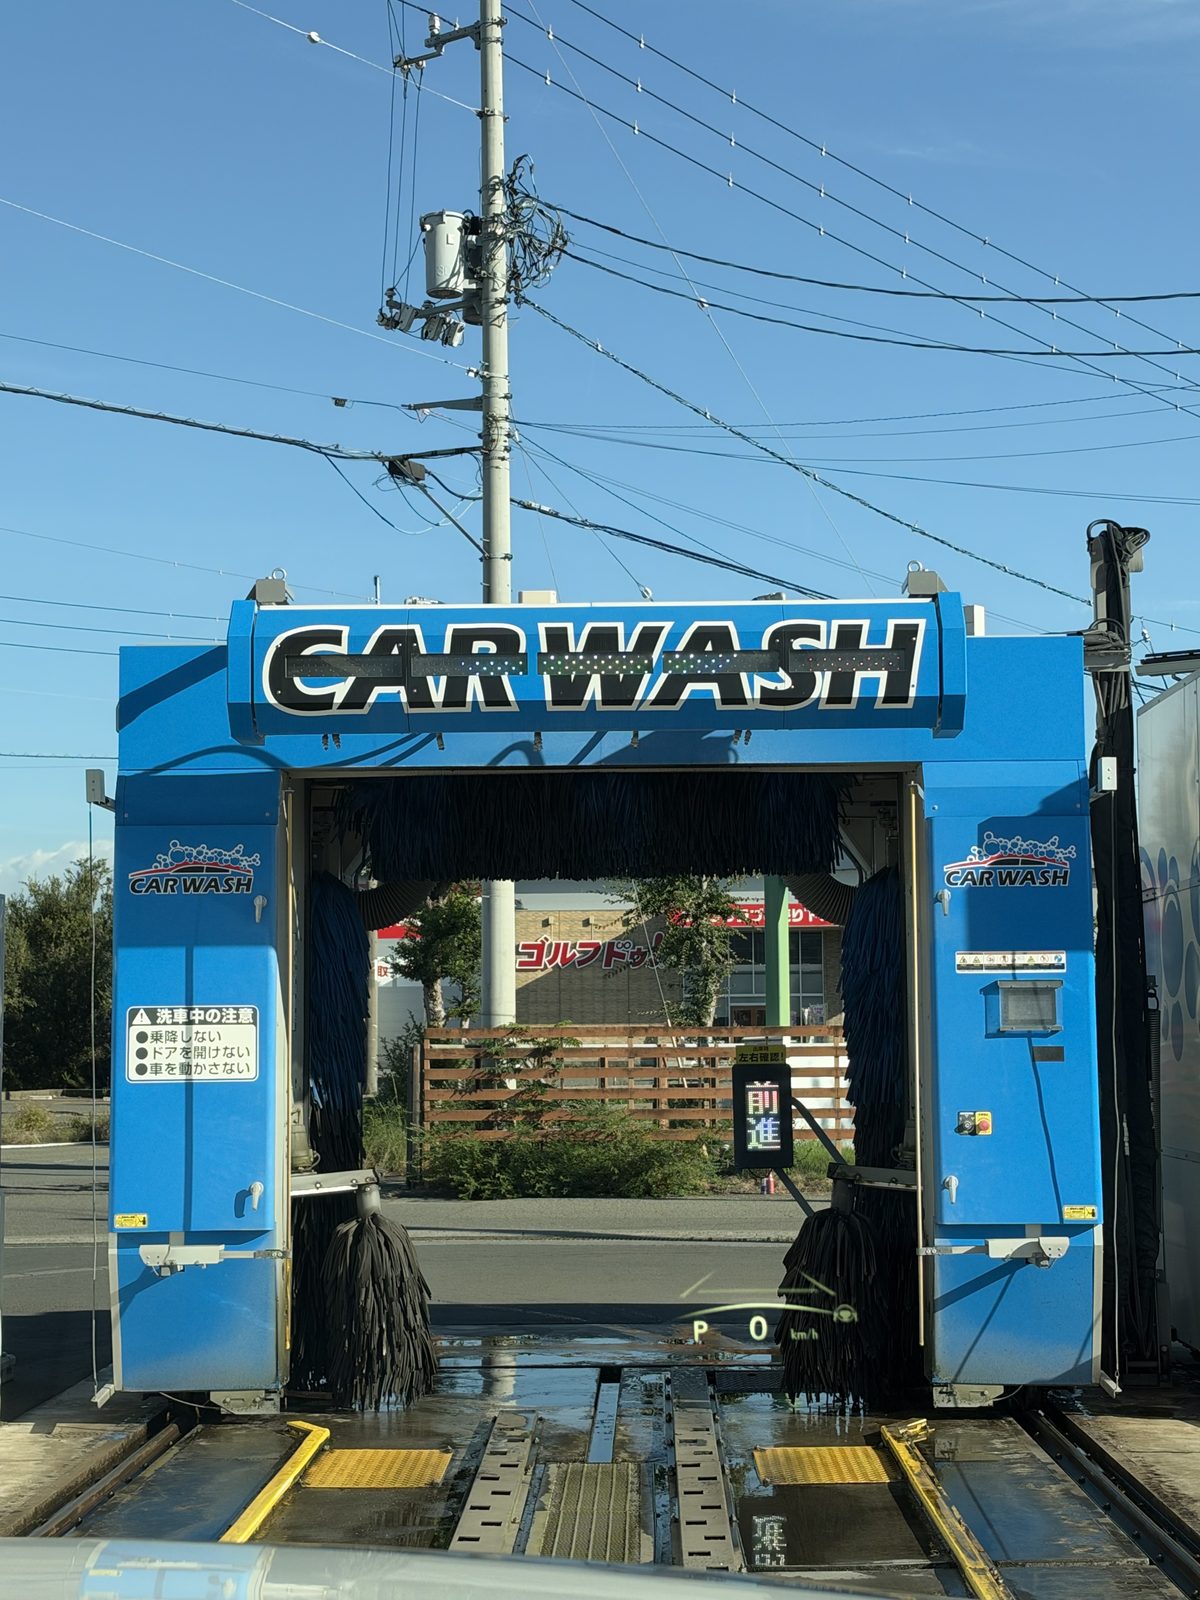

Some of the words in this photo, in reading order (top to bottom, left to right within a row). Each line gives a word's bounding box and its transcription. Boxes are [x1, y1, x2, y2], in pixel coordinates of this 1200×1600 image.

[263, 622, 527, 717] CAR
[536, 618, 926, 714] WASH
[129, 877, 179, 895] CAR
[181, 876, 254, 894] WASH
[945, 869, 994, 888] CAR
[996, 868, 1070, 887] WASH
[156, 1007, 254, 1025] 洗車中の注意
[149, 1030, 221, 1044] 乗降しない
[152, 1045, 250, 1060] ドアを開けない
[148, 1061, 250, 1076] 車を動かさない
[745, 1081, 781, 1149] 前進
[693, 1320, 708, 1343] P
[749, 1315, 768, 1341] 0
[790, 1328, 819, 1341] km/h
